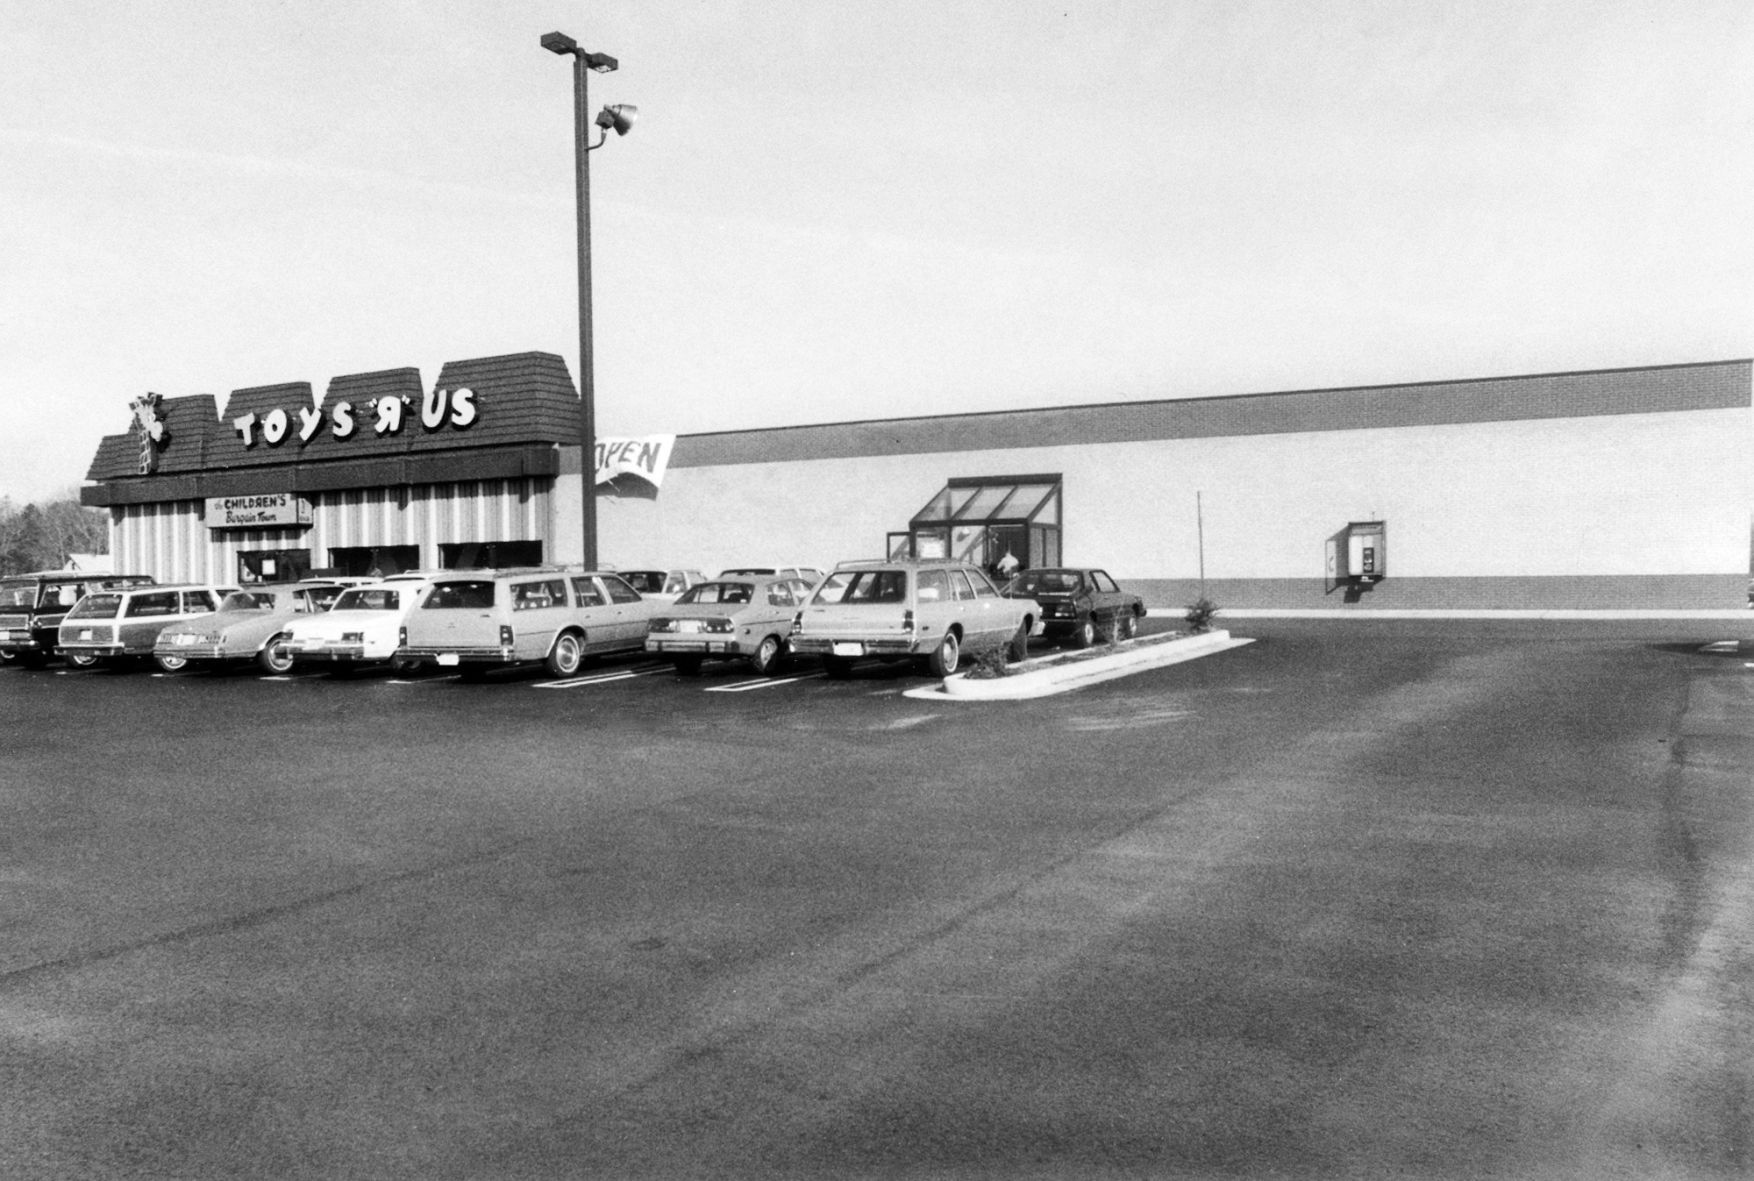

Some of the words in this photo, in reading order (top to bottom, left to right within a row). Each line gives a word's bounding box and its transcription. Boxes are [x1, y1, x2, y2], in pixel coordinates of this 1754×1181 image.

[233, 401, 354, 446] TOYS
[421, 388, 476, 428] US
[224, 494, 287, 510] CHILDREN'S
